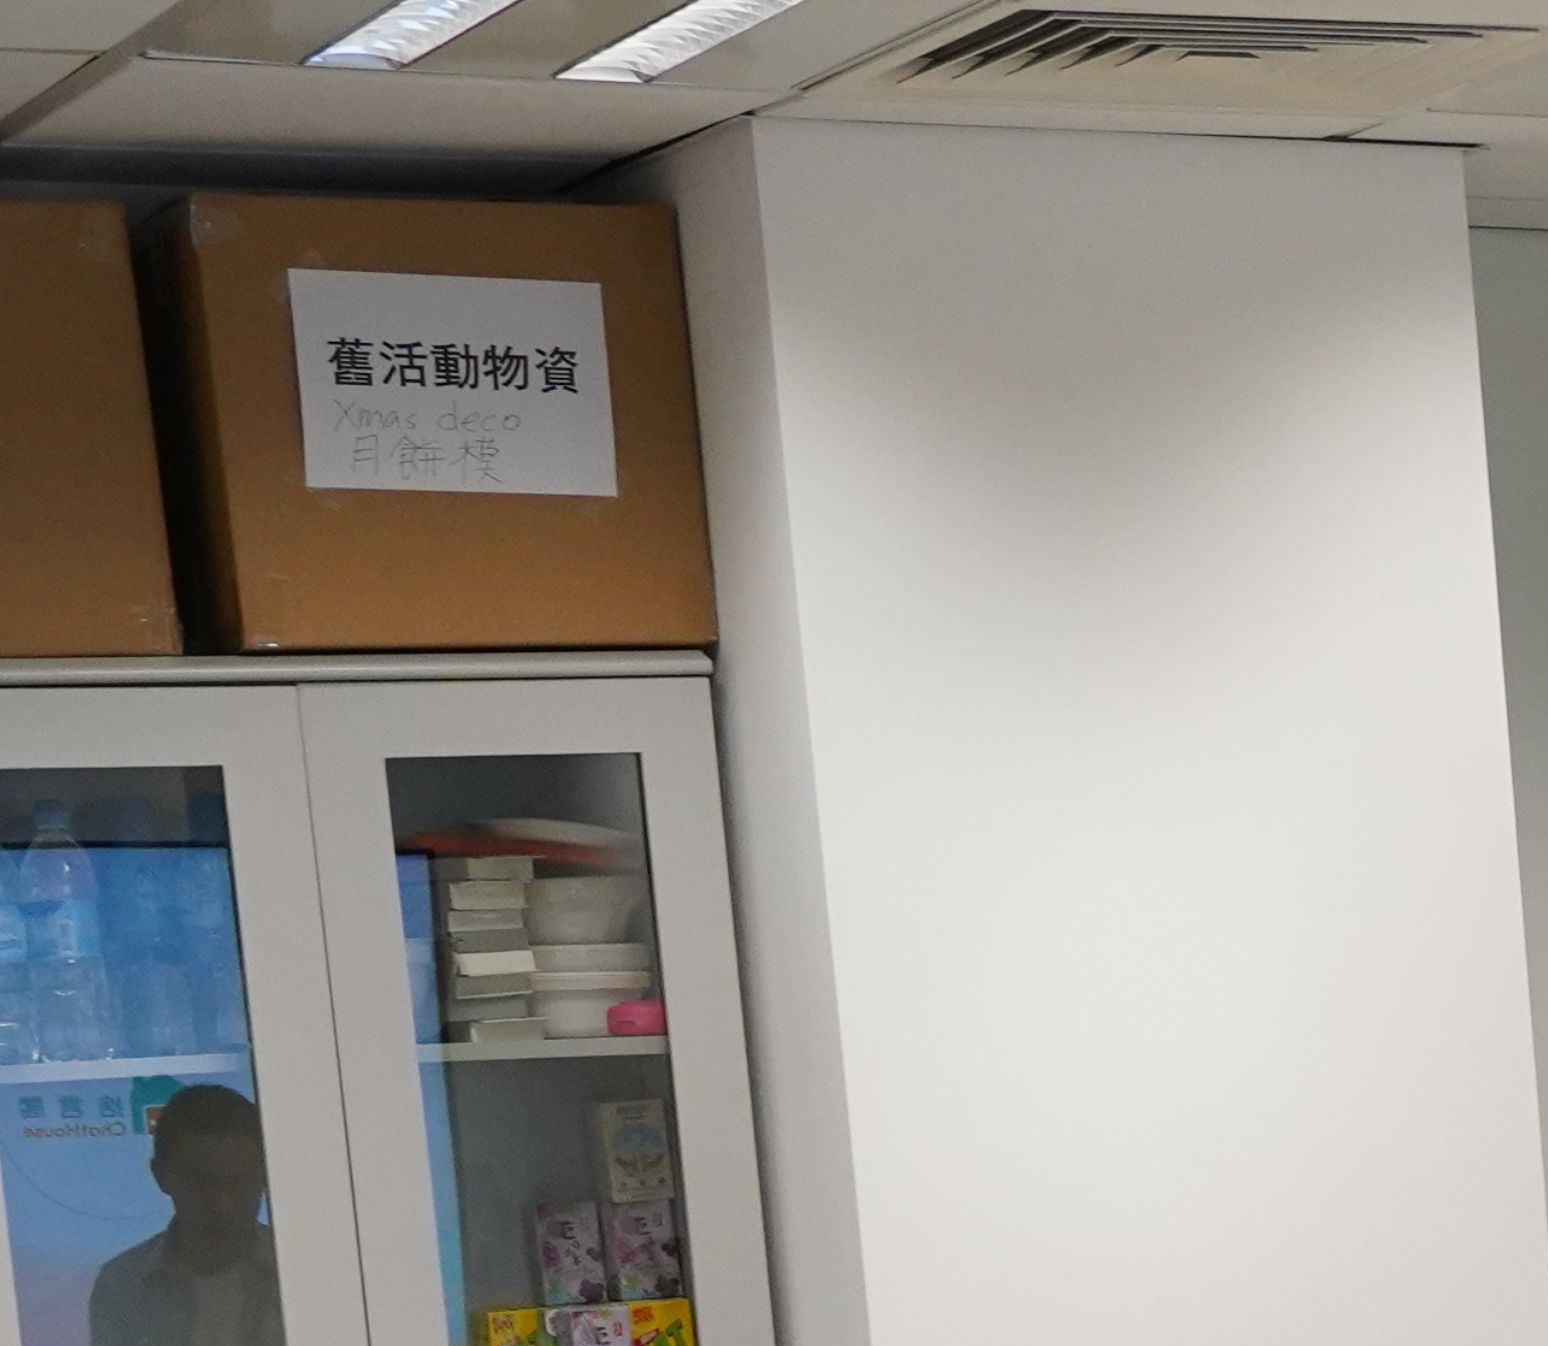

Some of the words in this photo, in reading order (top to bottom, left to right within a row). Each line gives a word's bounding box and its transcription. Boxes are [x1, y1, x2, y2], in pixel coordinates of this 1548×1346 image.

[327, 337, 580, 395] 舊活動物資
[333, 400, 417, 433] Xmas
[436, 399, 521, 432] deco
